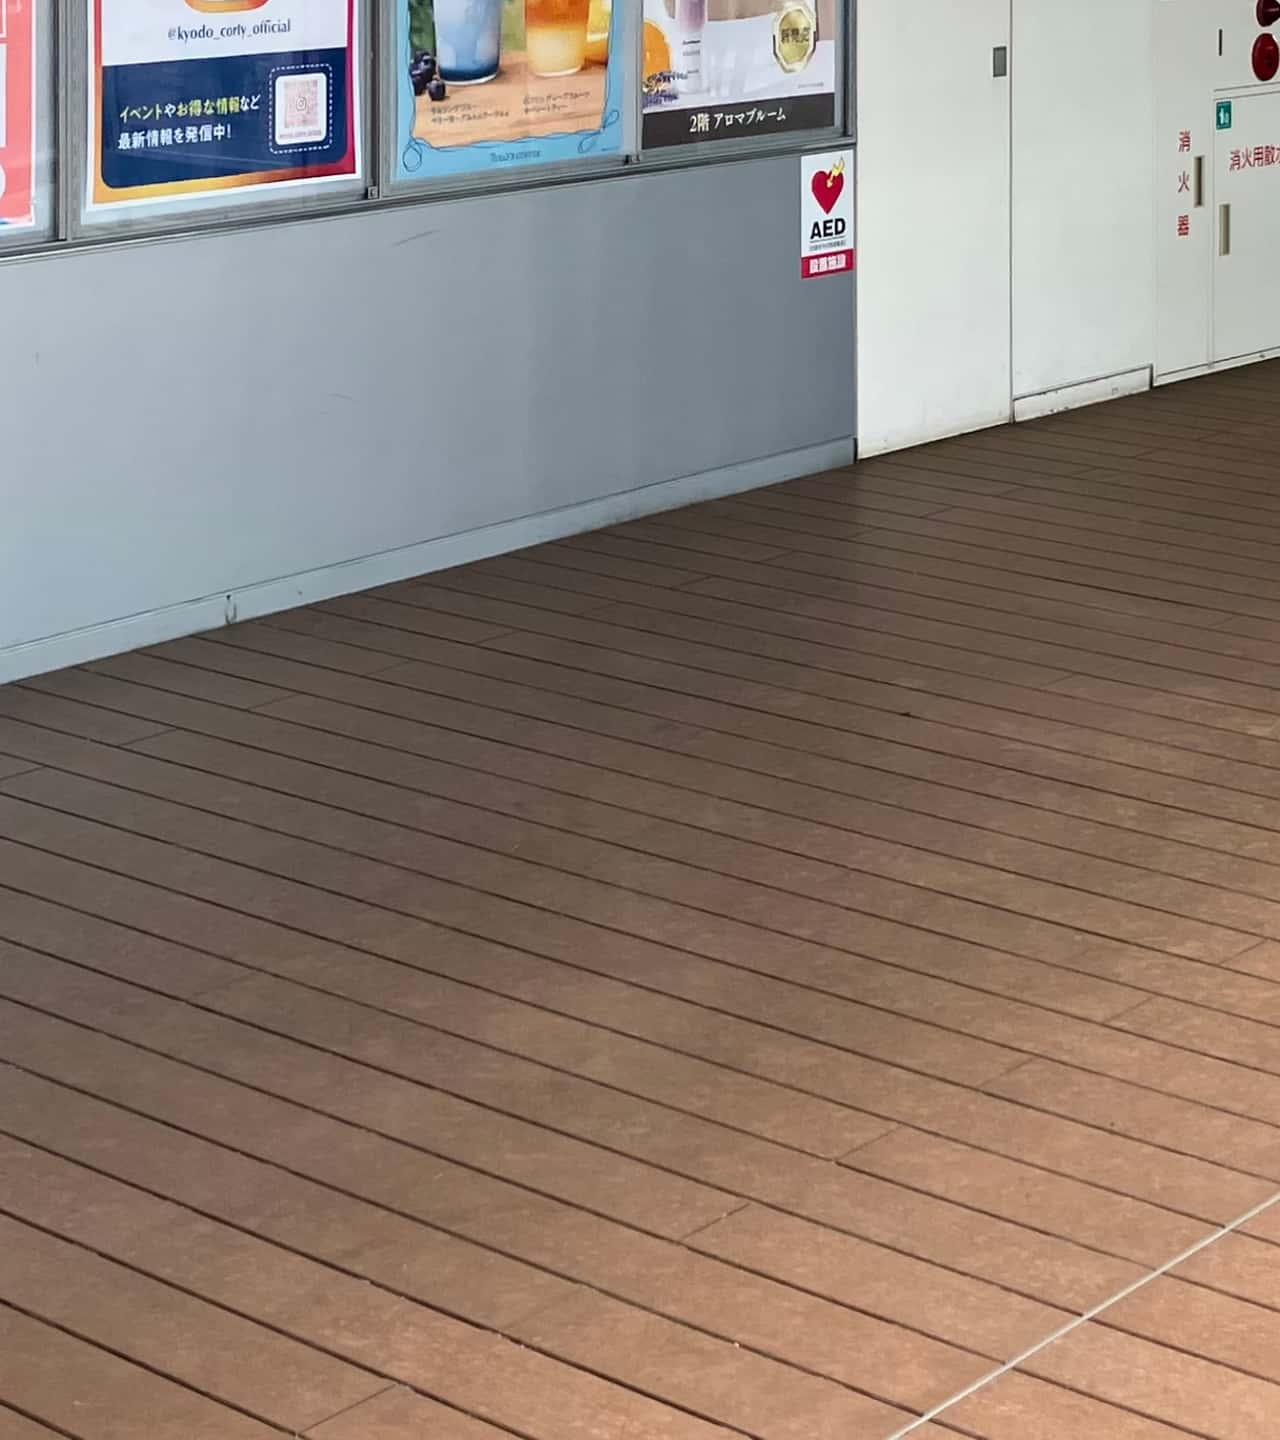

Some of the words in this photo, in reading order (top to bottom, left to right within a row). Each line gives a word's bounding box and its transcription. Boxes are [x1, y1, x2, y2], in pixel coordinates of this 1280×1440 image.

[167, 19, 291, 42] @kyodo_corty_official
[119, 94, 262, 125] イベントやお得な情報など
[689, 113, 710, 133] 2階
[713, 107, 787, 129] アロマブルーム
[117, 122, 233, 151] 最新情報を発信中!
[810, 218, 846, 240] AED
